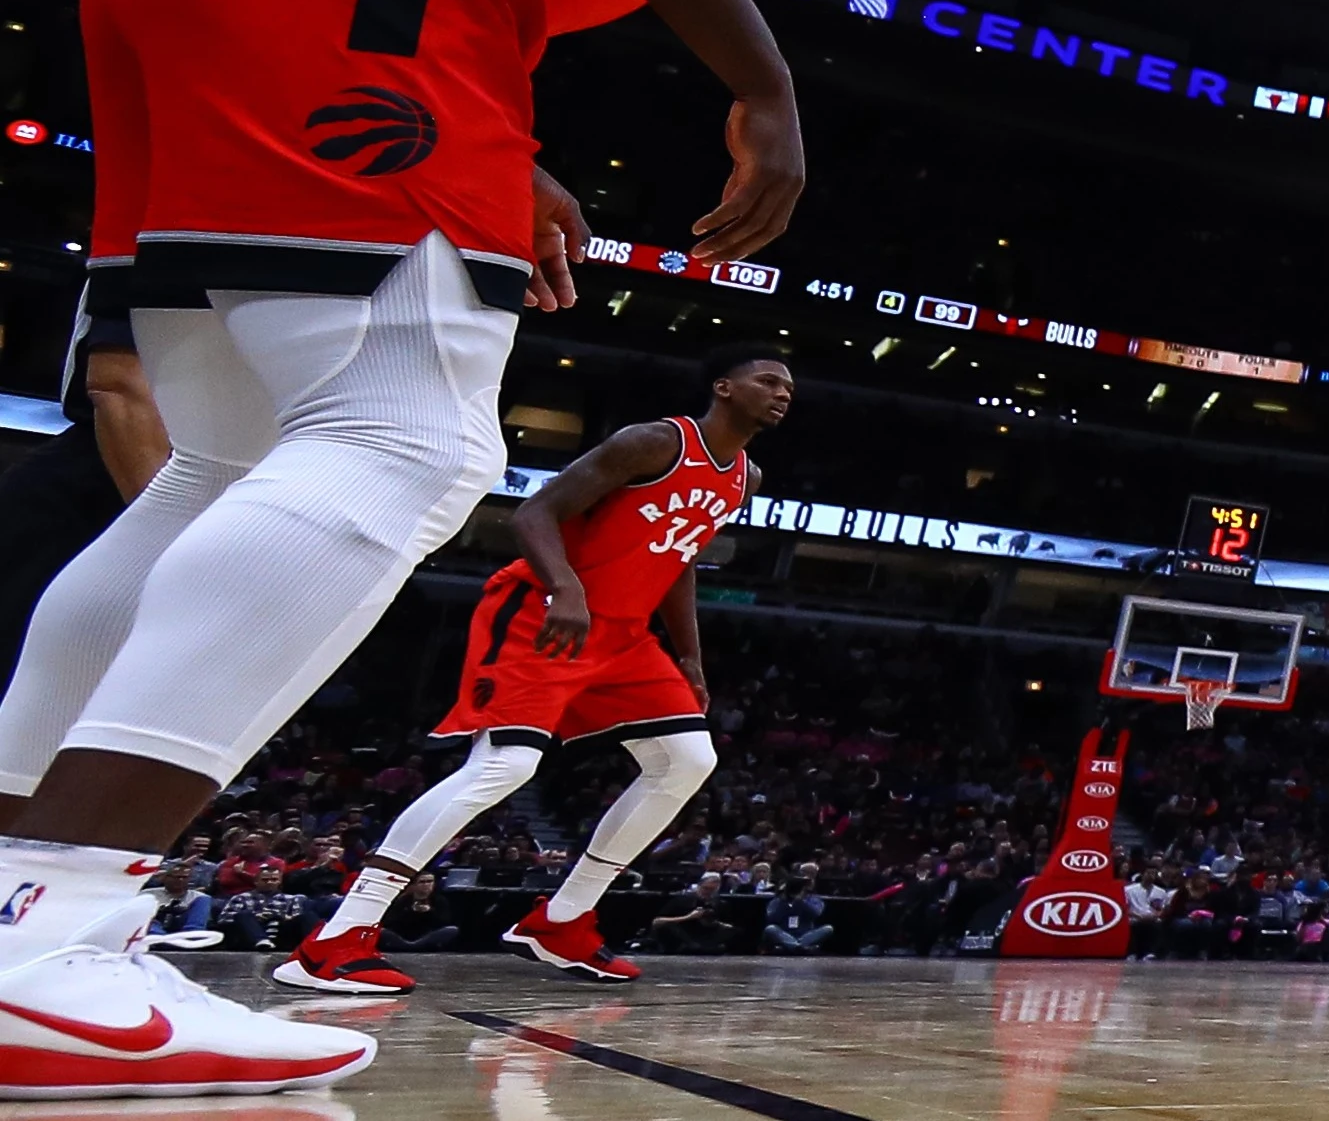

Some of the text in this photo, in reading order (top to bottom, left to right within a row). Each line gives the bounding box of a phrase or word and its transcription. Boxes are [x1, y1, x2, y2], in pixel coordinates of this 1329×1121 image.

[922, 1, 1230, 107] CENTER
[727, 264, 768, 287] 109
[805, 278, 854, 302] 4:51
[933, 303, 961, 322] 99
[1044, 320, 1098, 349] BULLS
[840, 507, 960, 552] BULLS
[1211, 506, 1258, 529] 4:51
[648, 515, 709, 564] 34
[1209, 528, 1250, 561] 12
[1200, 561, 1252, 578] TISSOT
[1090, 759, 1117, 774] ZTE
[1088, 784, 1111, 796] KIA
[1081, 818, 1104, 830] KIA
[1068, 854, 1101, 868] KIA
[1040, 901, 1105, 927] KIA
